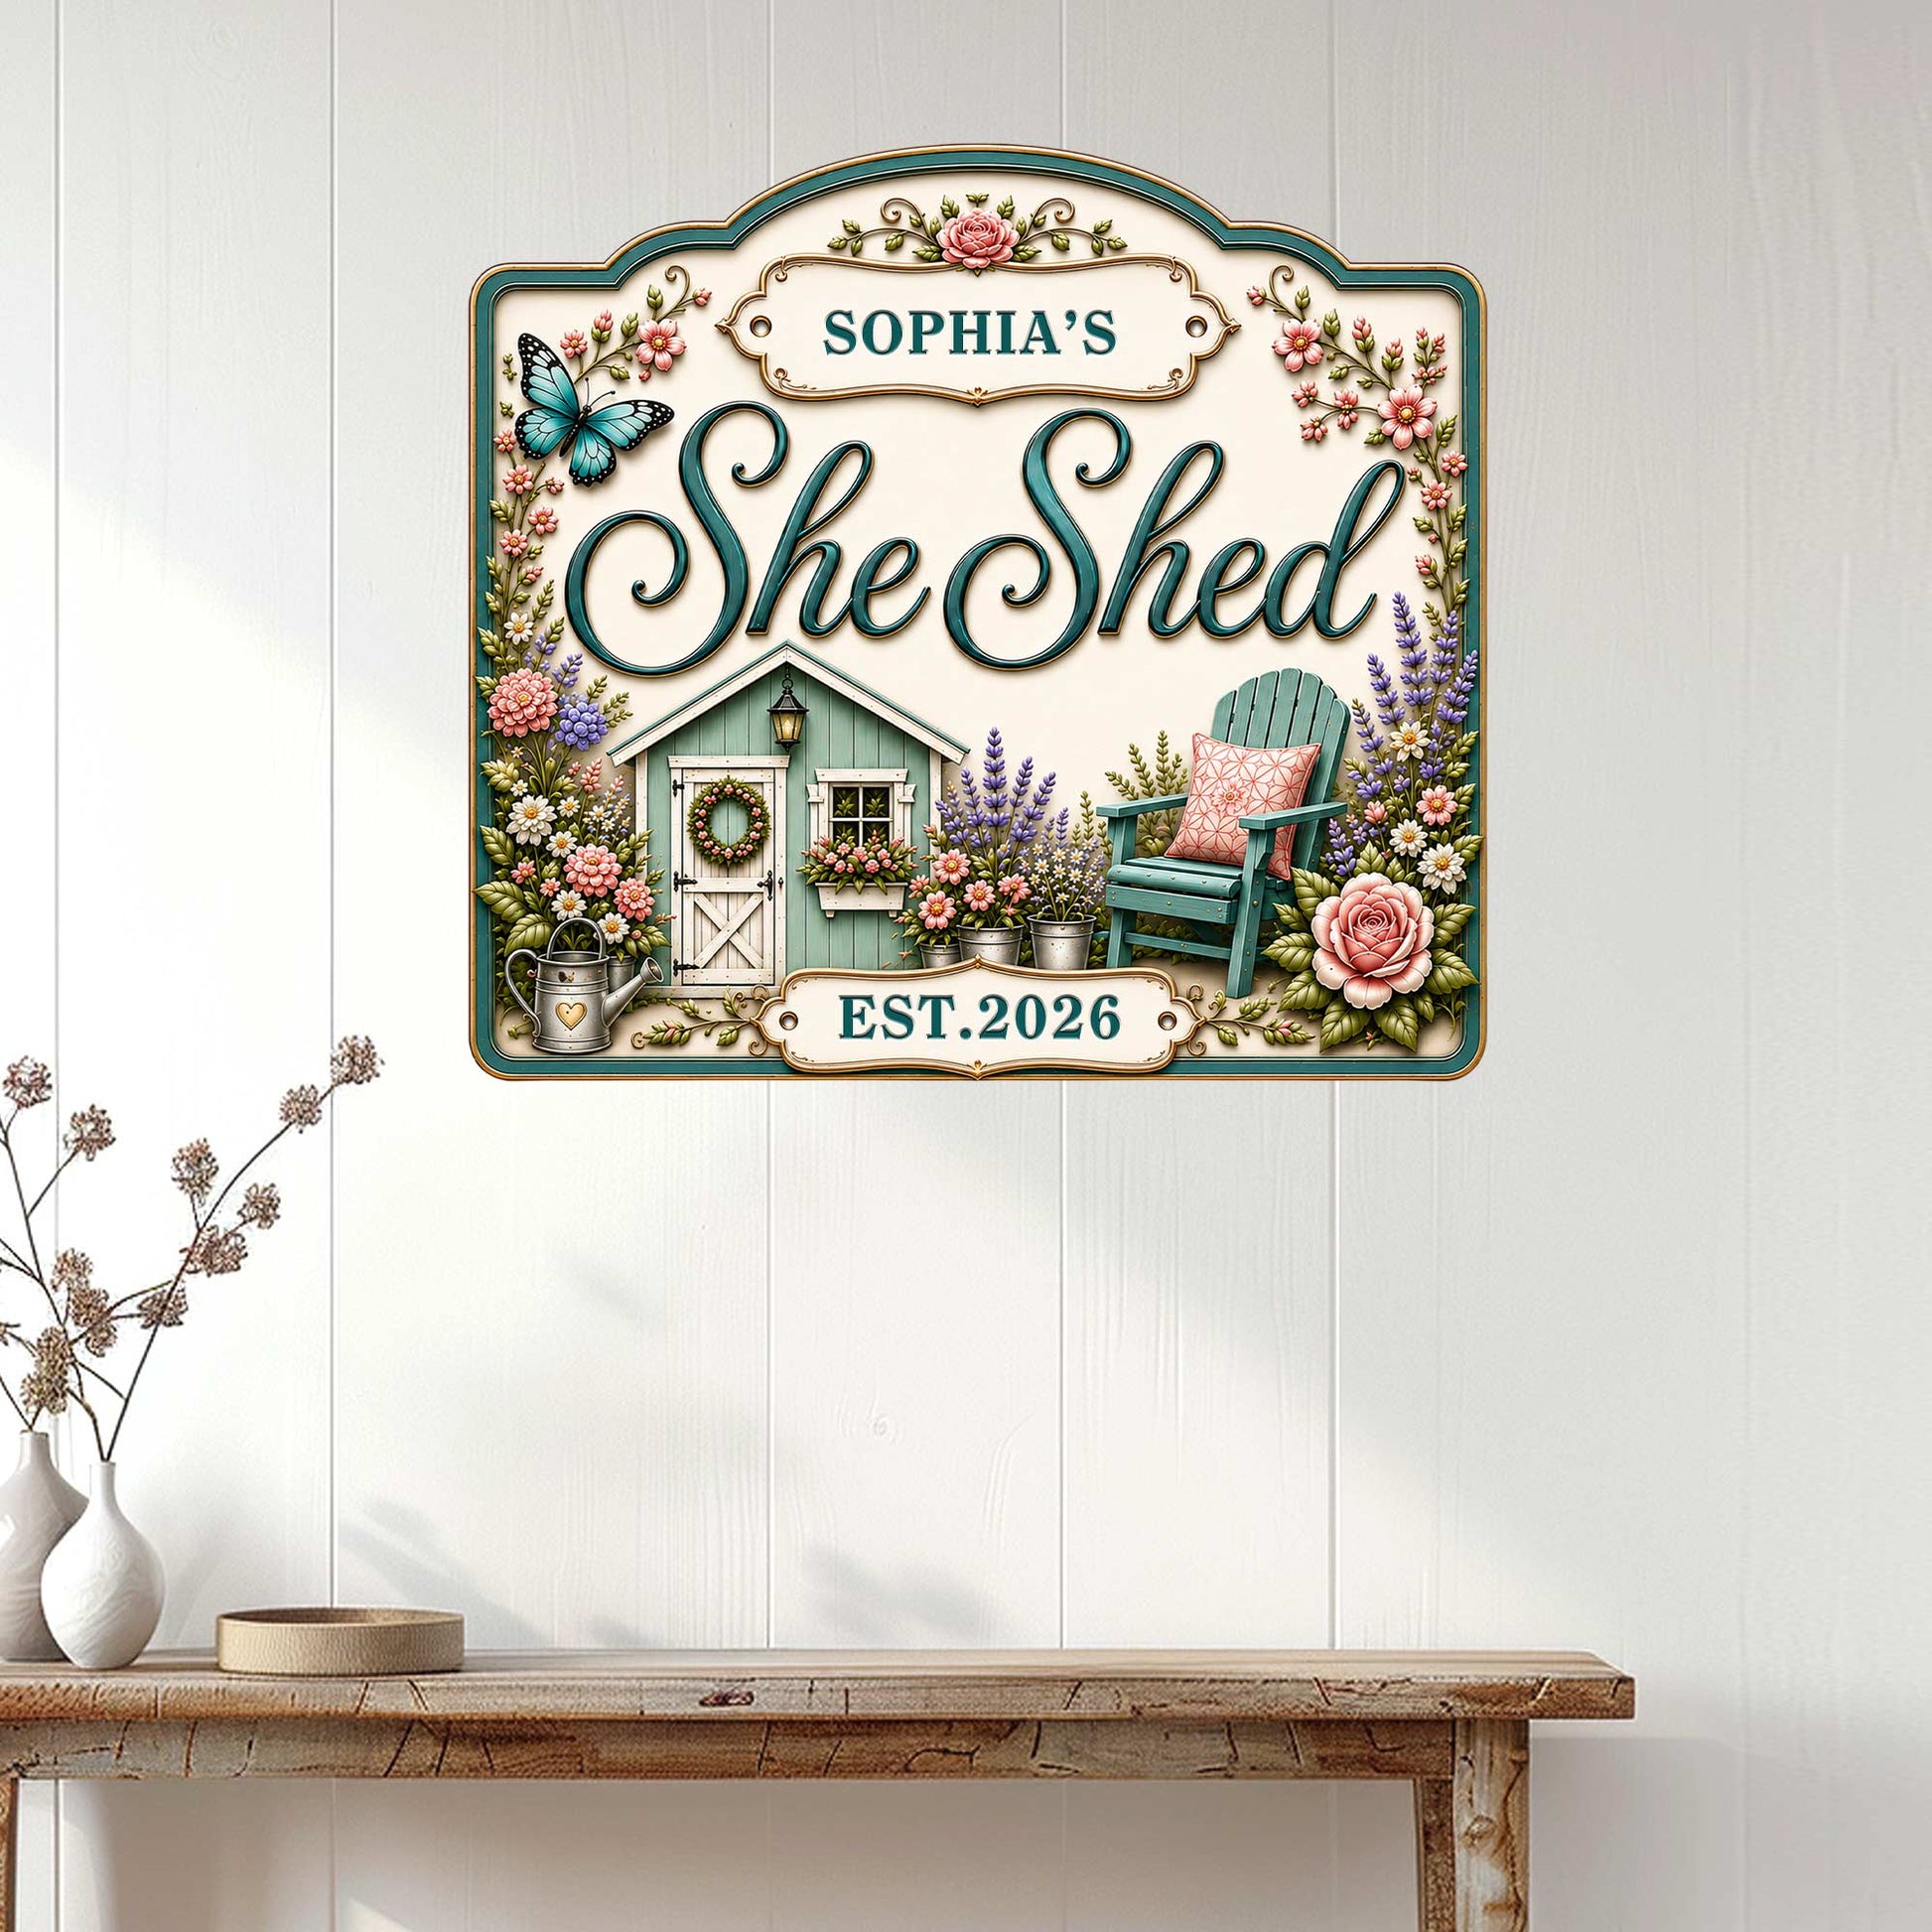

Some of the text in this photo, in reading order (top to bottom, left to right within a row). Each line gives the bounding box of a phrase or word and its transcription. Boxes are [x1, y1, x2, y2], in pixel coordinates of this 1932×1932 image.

[823, 308, 1117, 356] SOPHIA’S
[564, 400, 1406, 678] She Shed
[838, 994, 1122, 1040] EST.2026
